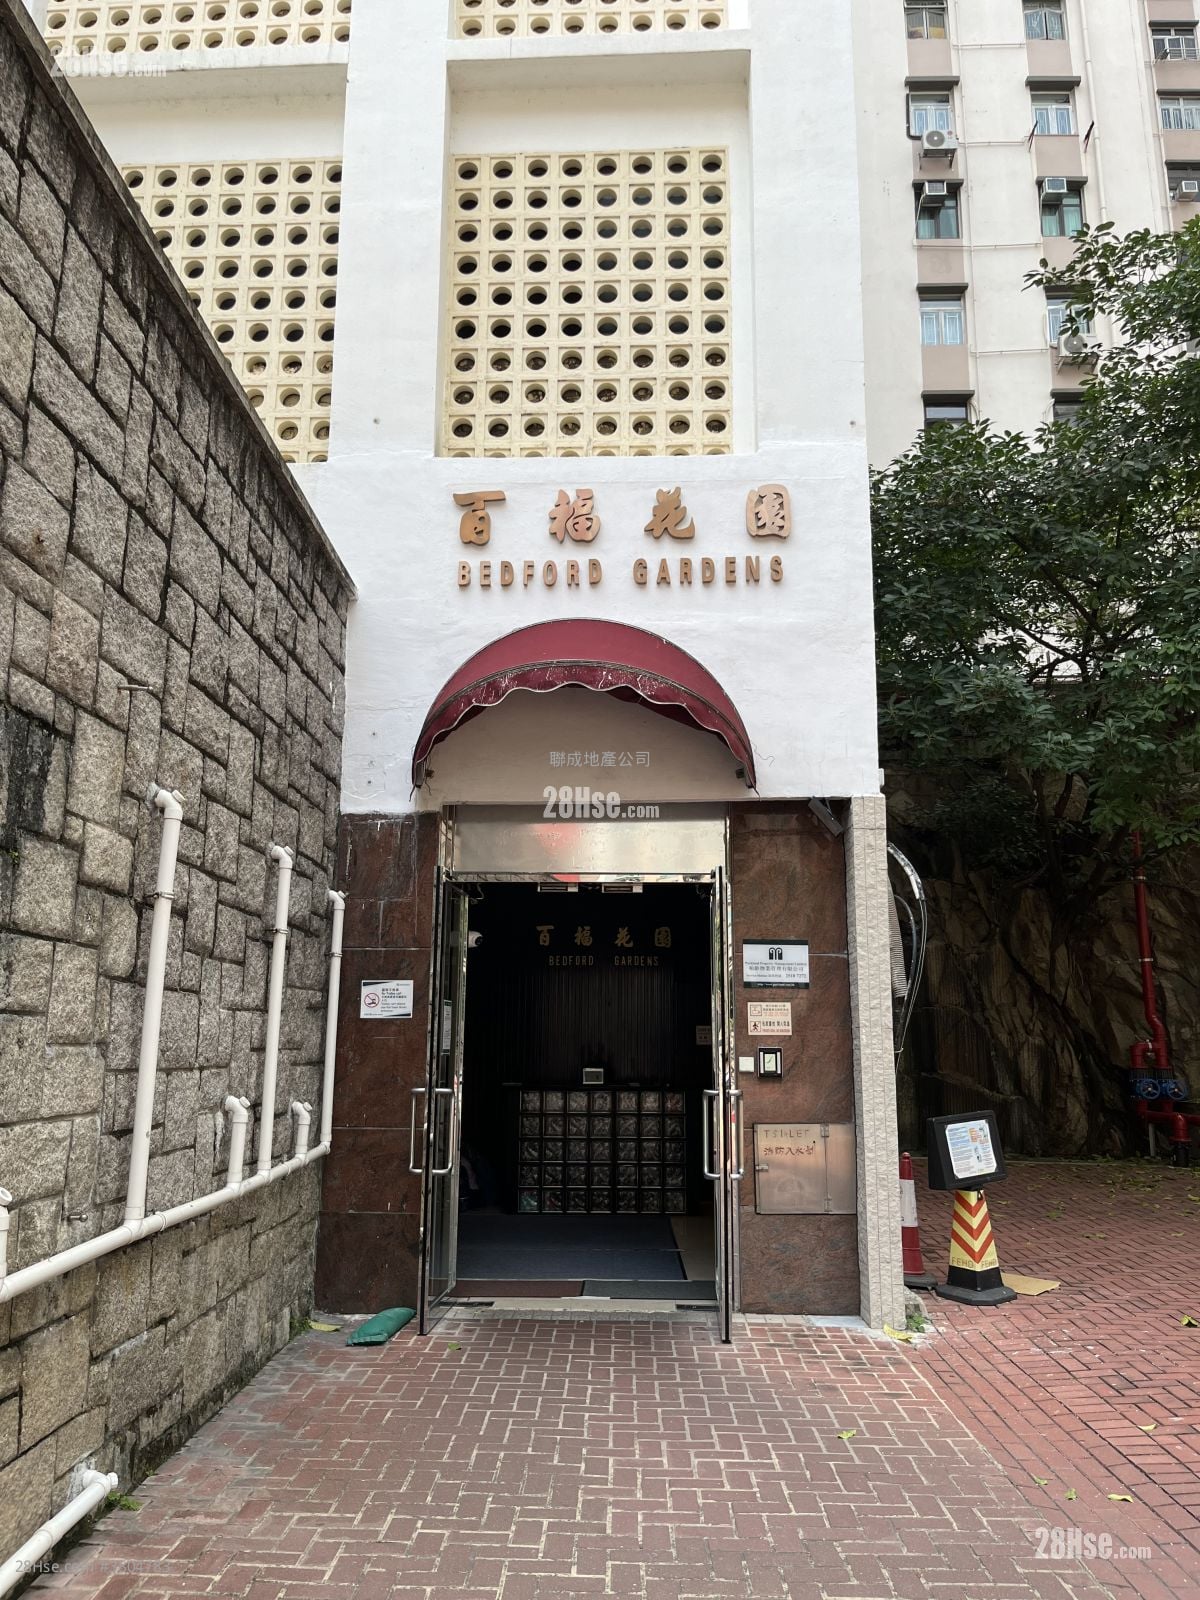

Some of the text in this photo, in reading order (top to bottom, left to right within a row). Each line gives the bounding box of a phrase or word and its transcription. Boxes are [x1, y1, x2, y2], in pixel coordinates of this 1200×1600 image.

[452, 483, 792, 546] 百福花園
[457, 554, 785, 588] BEDFORD GARDENS
[535, 925, 672, 948] 百福花園
[549, 955, 659, 967] BEDFORD GARDENS
